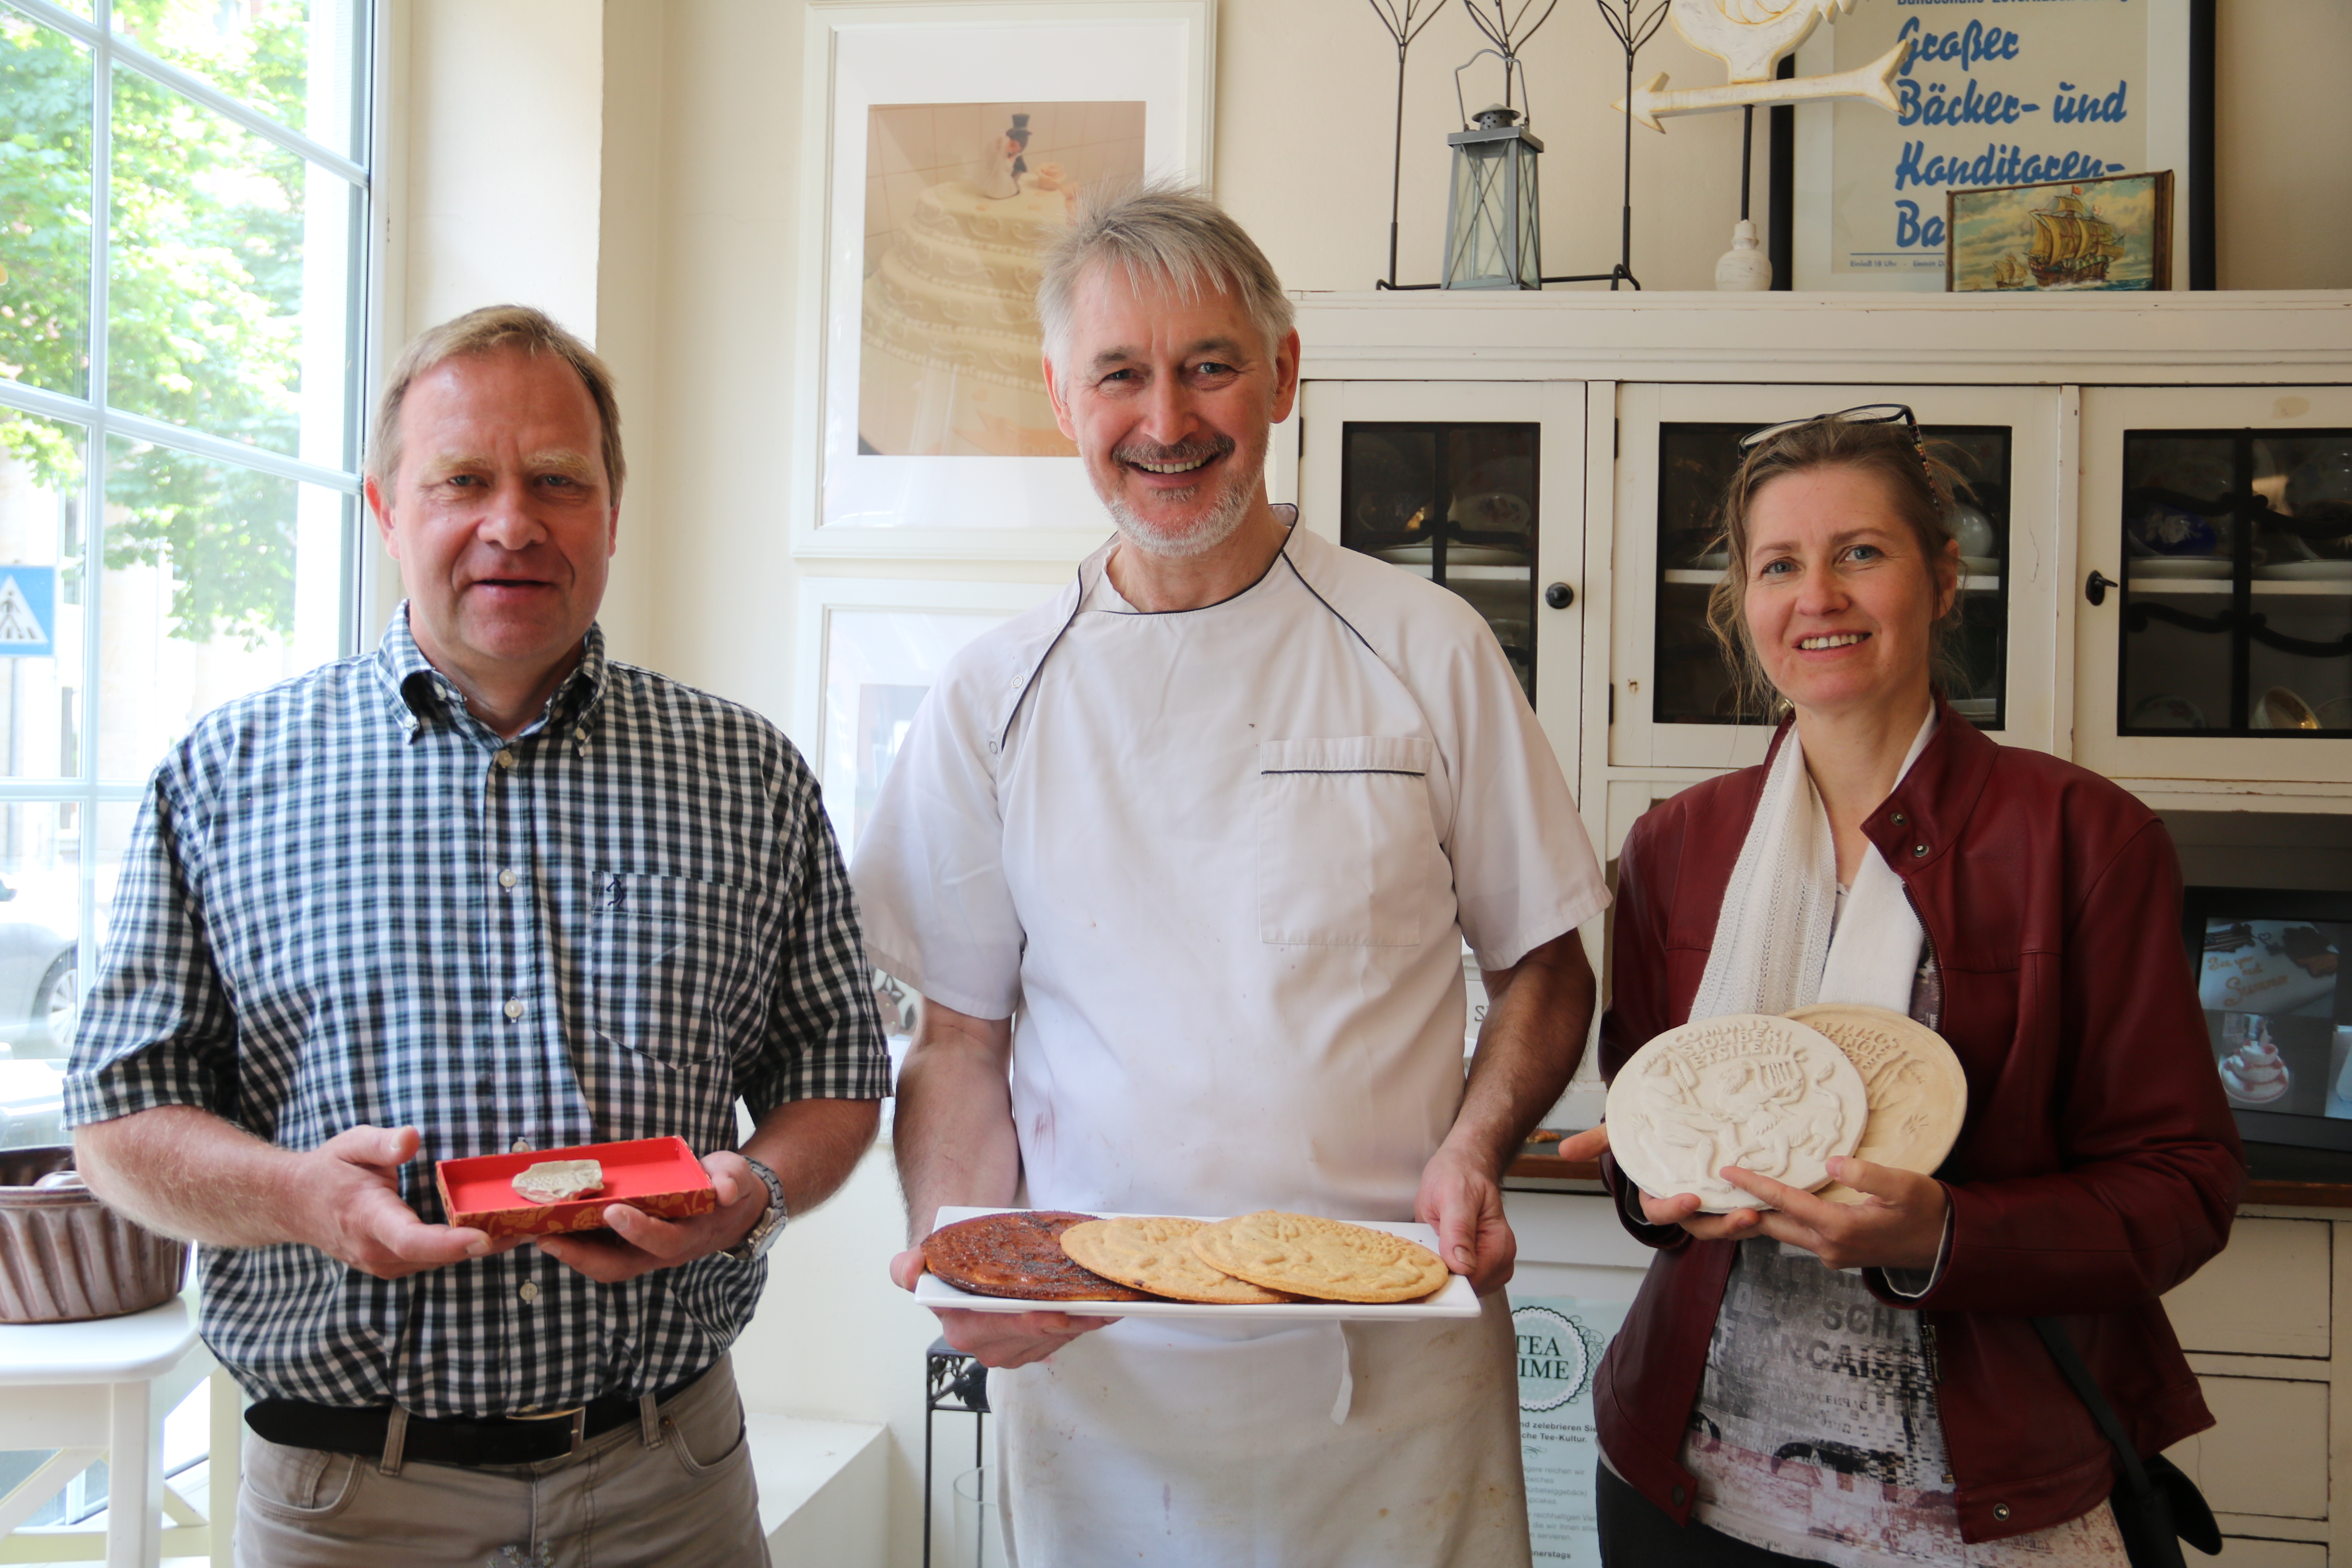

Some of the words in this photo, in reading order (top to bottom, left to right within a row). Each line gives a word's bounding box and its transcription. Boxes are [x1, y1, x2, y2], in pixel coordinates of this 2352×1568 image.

[1898, 16, 2019, 76] Großer
[1897, 78, 2040, 126] Bäcker-
[1895, 140, 2125, 191] Konditoren-
[1895, 199, 1945, 248] Ba
[1516, 1335, 1562, 1357] TEA
[1518, 1357, 1569, 1379] IME
[1533, 1422, 1581, 1431] zelebrieren
[1540, 1433, 1587, 1443] Tee-Kultur.
[1524, 1475, 1554, 1483] dwiches
[1534, 1512, 1580, 1521] reichhaltigen
[1532, 1550, 1571, 1560] nerstags
